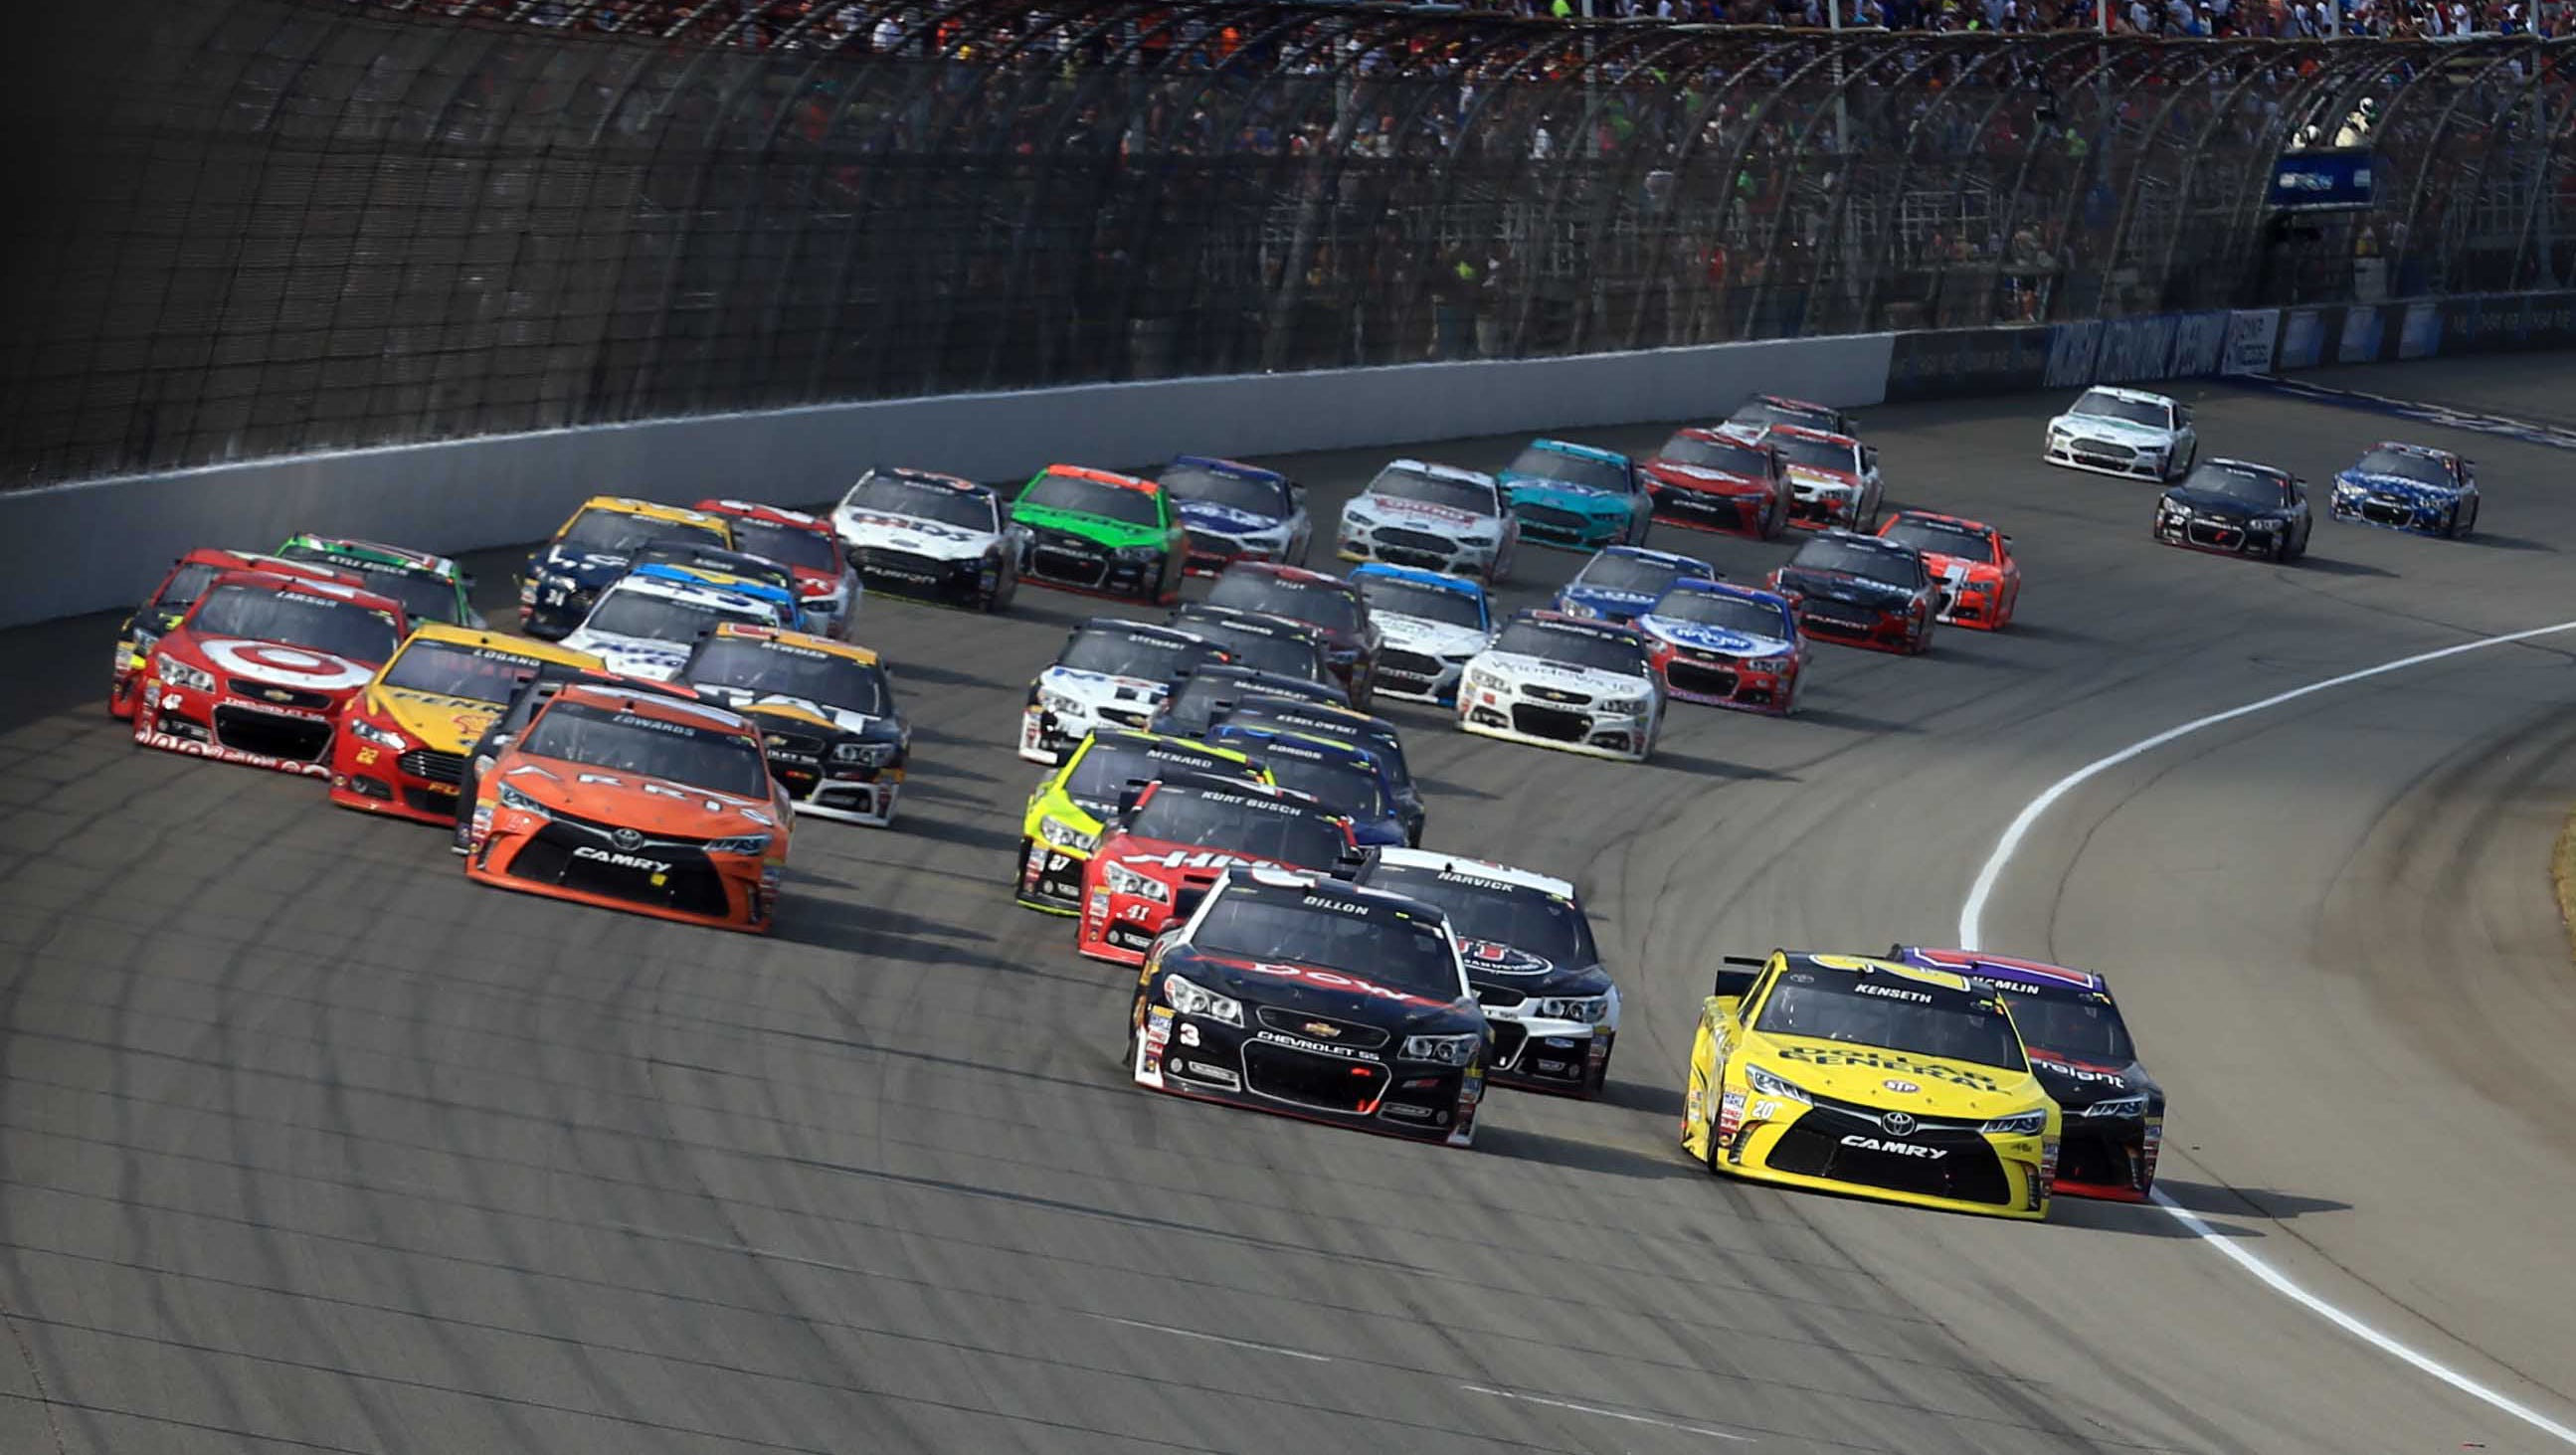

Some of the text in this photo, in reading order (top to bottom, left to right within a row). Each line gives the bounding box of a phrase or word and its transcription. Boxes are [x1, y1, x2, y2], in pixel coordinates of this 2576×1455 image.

[275, 591, 339, 609] LARSON
[472, 648, 541, 667] LOGANO
[612, 713, 696, 737] EDWARDS
[1146, 749, 1212, 770] MENARD
[1200, 790, 1303, 818] KURT BUSCH
[572, 845, 672, 872] CAMRY
[1437, 871, 1516, 893] HARVICK
[1126, 905, 1151, 922] 41
[1303, 895, 1370, 916] DILLON
[1254, 962, 1417, 1001] DOW
[1854, 983, 1933, 1004] KENSETH
[1179, 1022, 1201, 1047] 3
[1256, 1030, 1354, 1056] CHEVROLET
[1777, 1050, 2014, 1097] GENERAL
[1792, 1046, 1993, 1083] DOLLAR
[1750, 1099, 1775, 1120] 20
[1840, 1133, 1949, 1161] CAMRY
